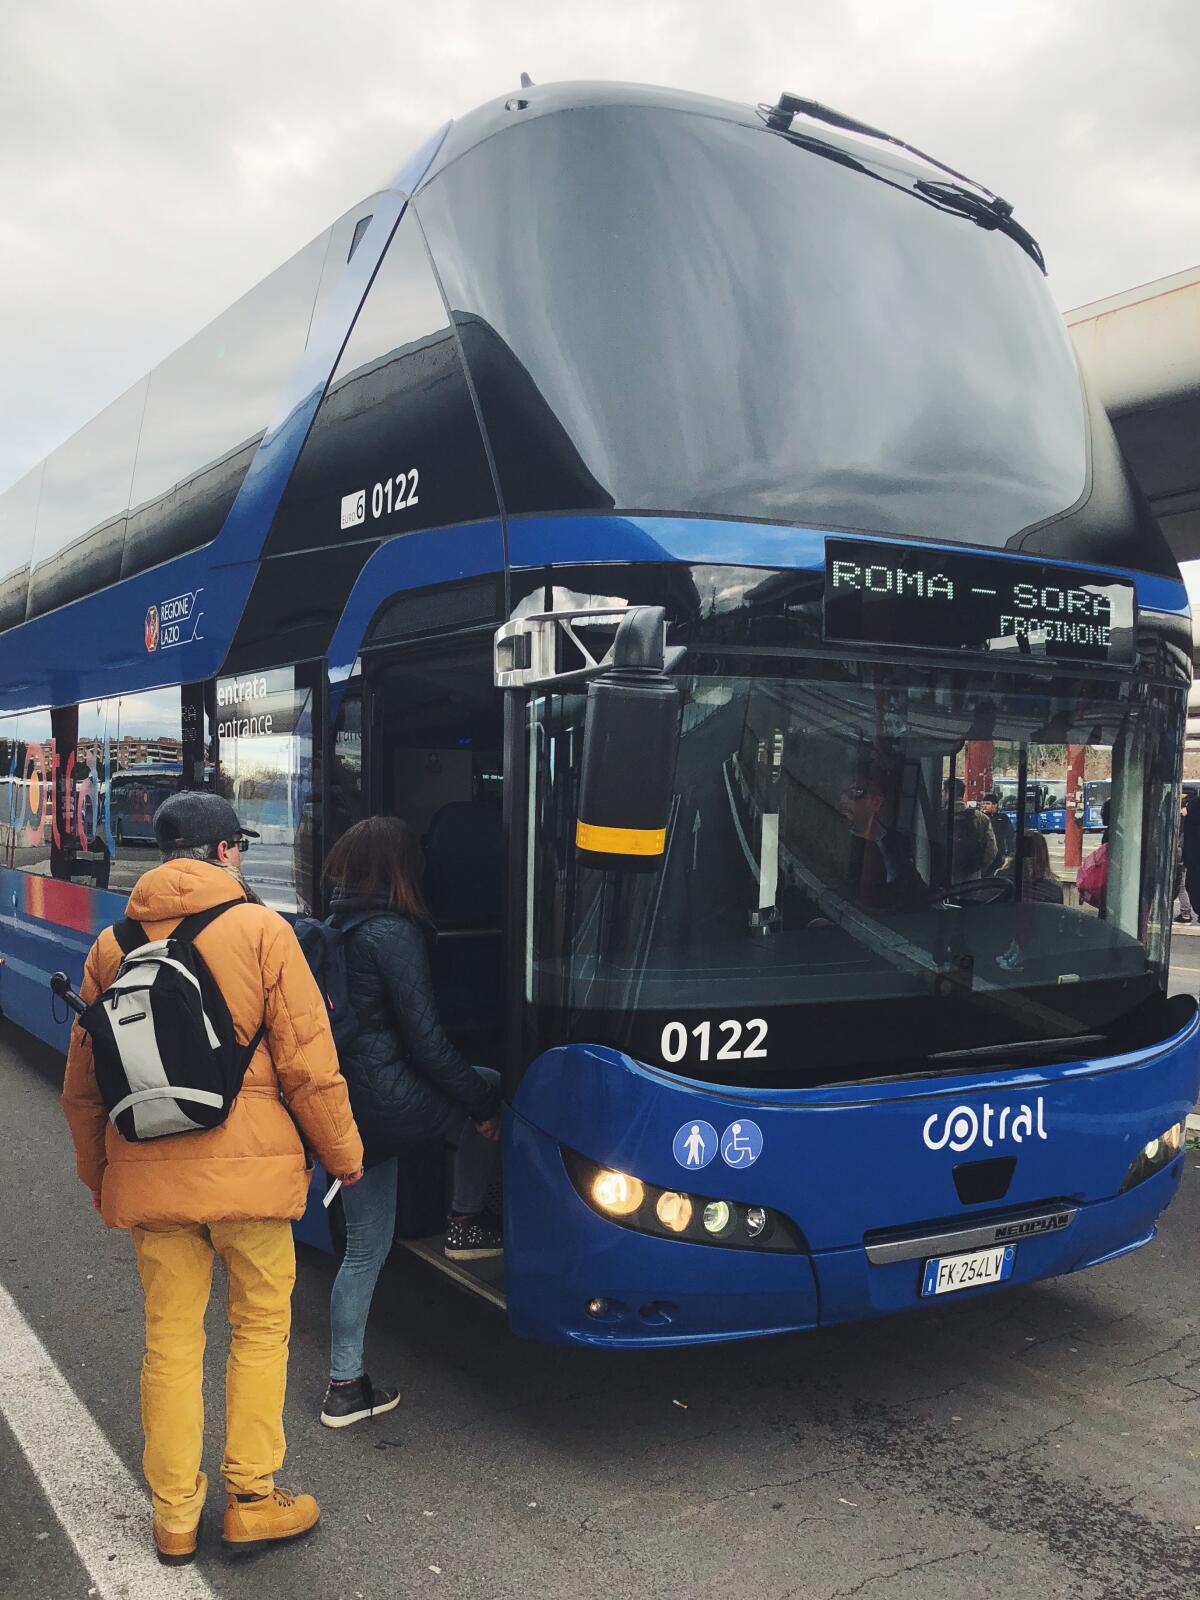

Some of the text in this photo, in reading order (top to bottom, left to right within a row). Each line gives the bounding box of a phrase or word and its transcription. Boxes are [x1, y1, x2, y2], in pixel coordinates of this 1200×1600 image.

[356, 495, 364, 520] 6
[371, 468, 419, 519] 0122
[832, 560, 954, 600] ROMA
[1013, 583, 1116, 617] SORA
[160, 597, 189, 622] REGIONE
[160, 625, 180, 645] LAZIO
[999, 614, 1113, 646] FROSINONE
[216, 676, 267, 707] entrata
[218, 714, 273, 740] entrance
[660, 1018, 769, 1063] 0122
[922, 1096, 1048, 1152] cotral
[994, 1214, 1070, 1239] NEOPLAN
